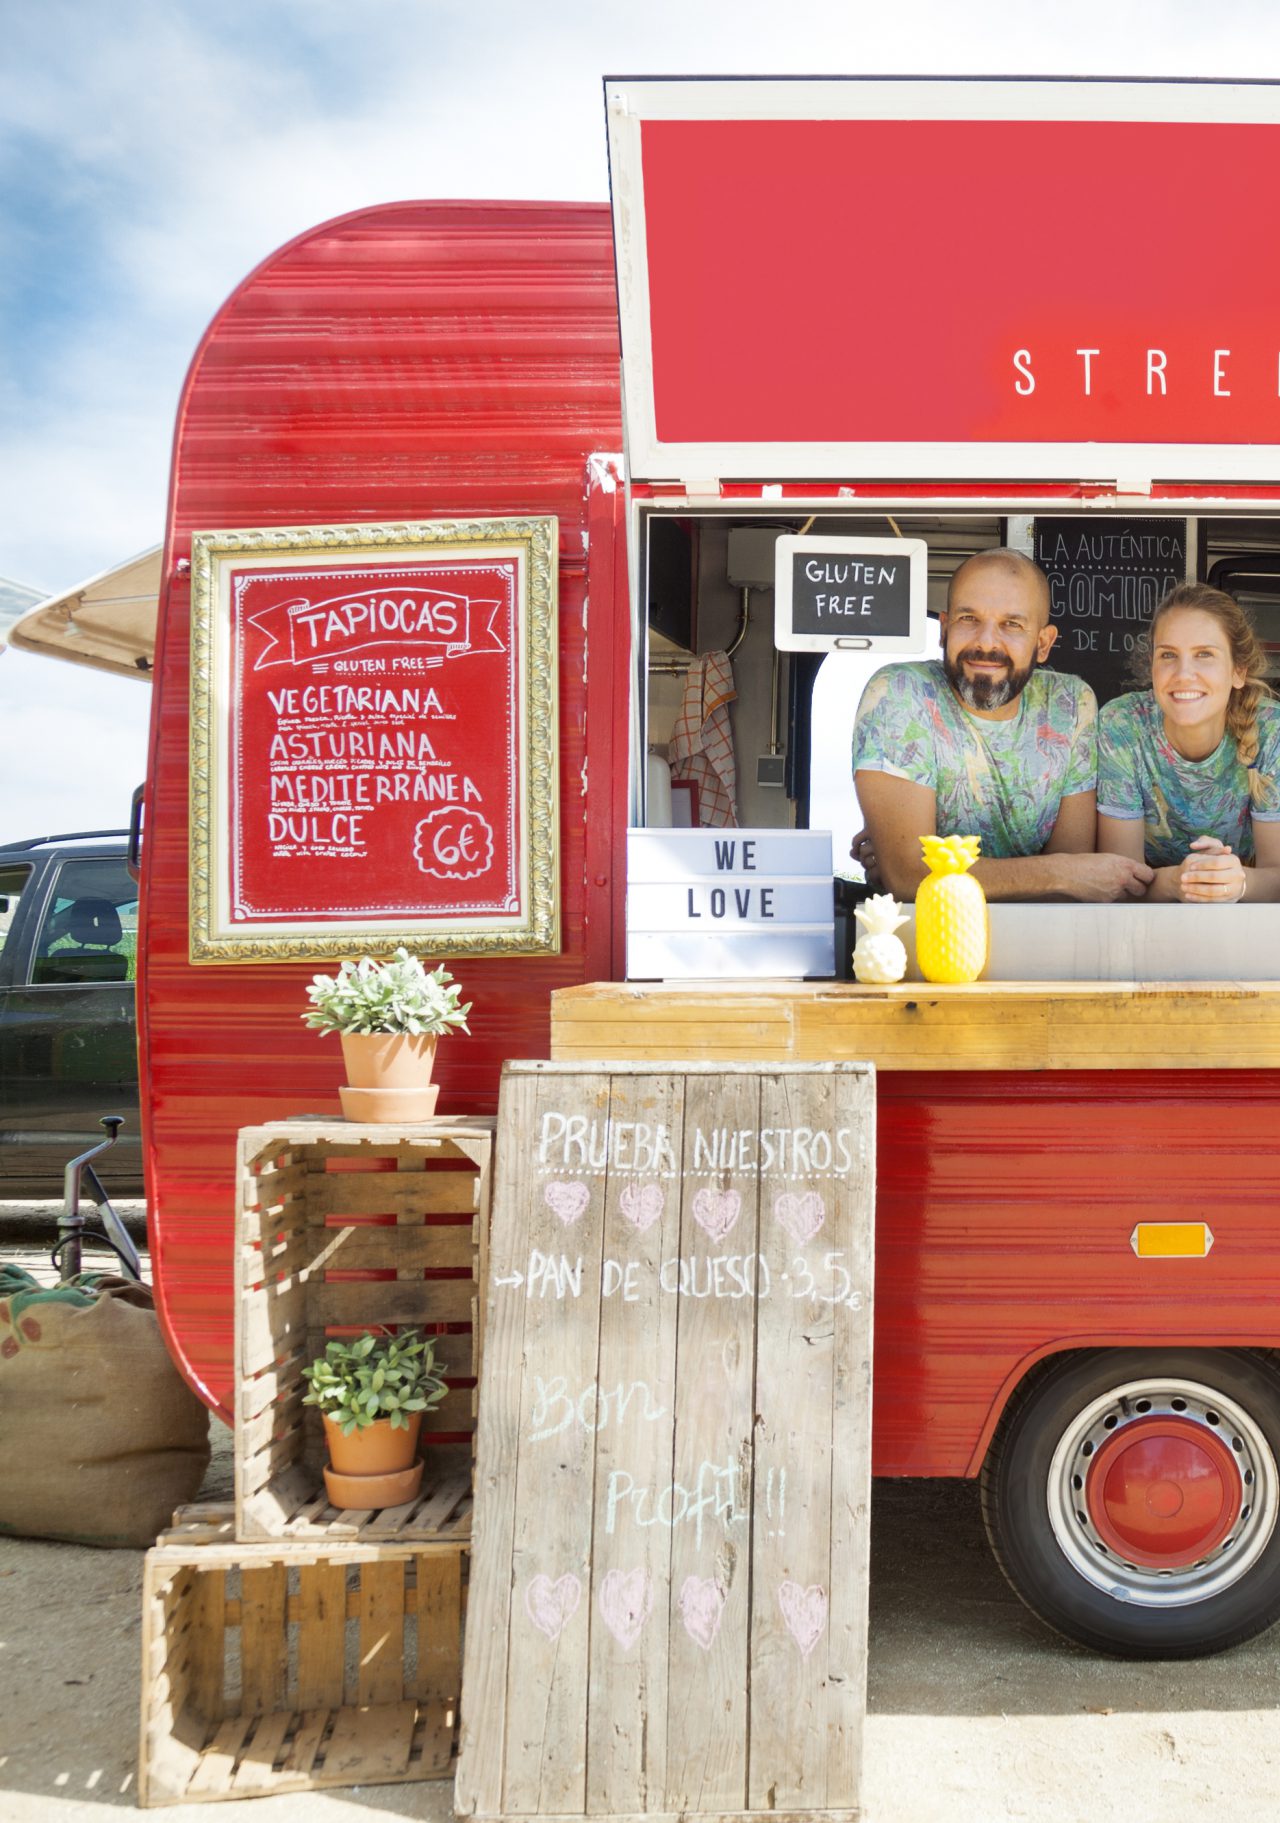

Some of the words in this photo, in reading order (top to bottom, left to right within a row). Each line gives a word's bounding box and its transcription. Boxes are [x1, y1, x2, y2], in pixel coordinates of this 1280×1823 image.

[1039, 533, 1070, 562] LA
[1075, 528, 1184, 561] AUTÉNTICA
[804, 559, 897, 585] GLUTEN
[814, 592, 875, 618] FREE
[296, 598, 458, 648] TAPIOCAS
[1072, 628, 1101, 651] DE
[1108, 631, 1150, 652] LOS
[333, 658, 386, 673] GLUTEN
[391, 656, 425, 671] FREE
[266, 682, 444, 715] VEGETARIANA
[269, 726, 437, 760] ASTURIANA
[267, 813, 366, 846] DULCE
[432, 822, 480, 866] 6€
[714, 840, 757, 871] WE
[687, 888, 775, 919] LOVE
[537, 1111, 677, 1171] PRUEBA
[693, 1126, 853, 1174] NUESTROS
[526, 1249, 583, 1300] PAN
[601, 1259, 641, 1302] DE
[659, 1252, 771, 1300] QUESO
[528, 1375, 668, 1442] Bon
